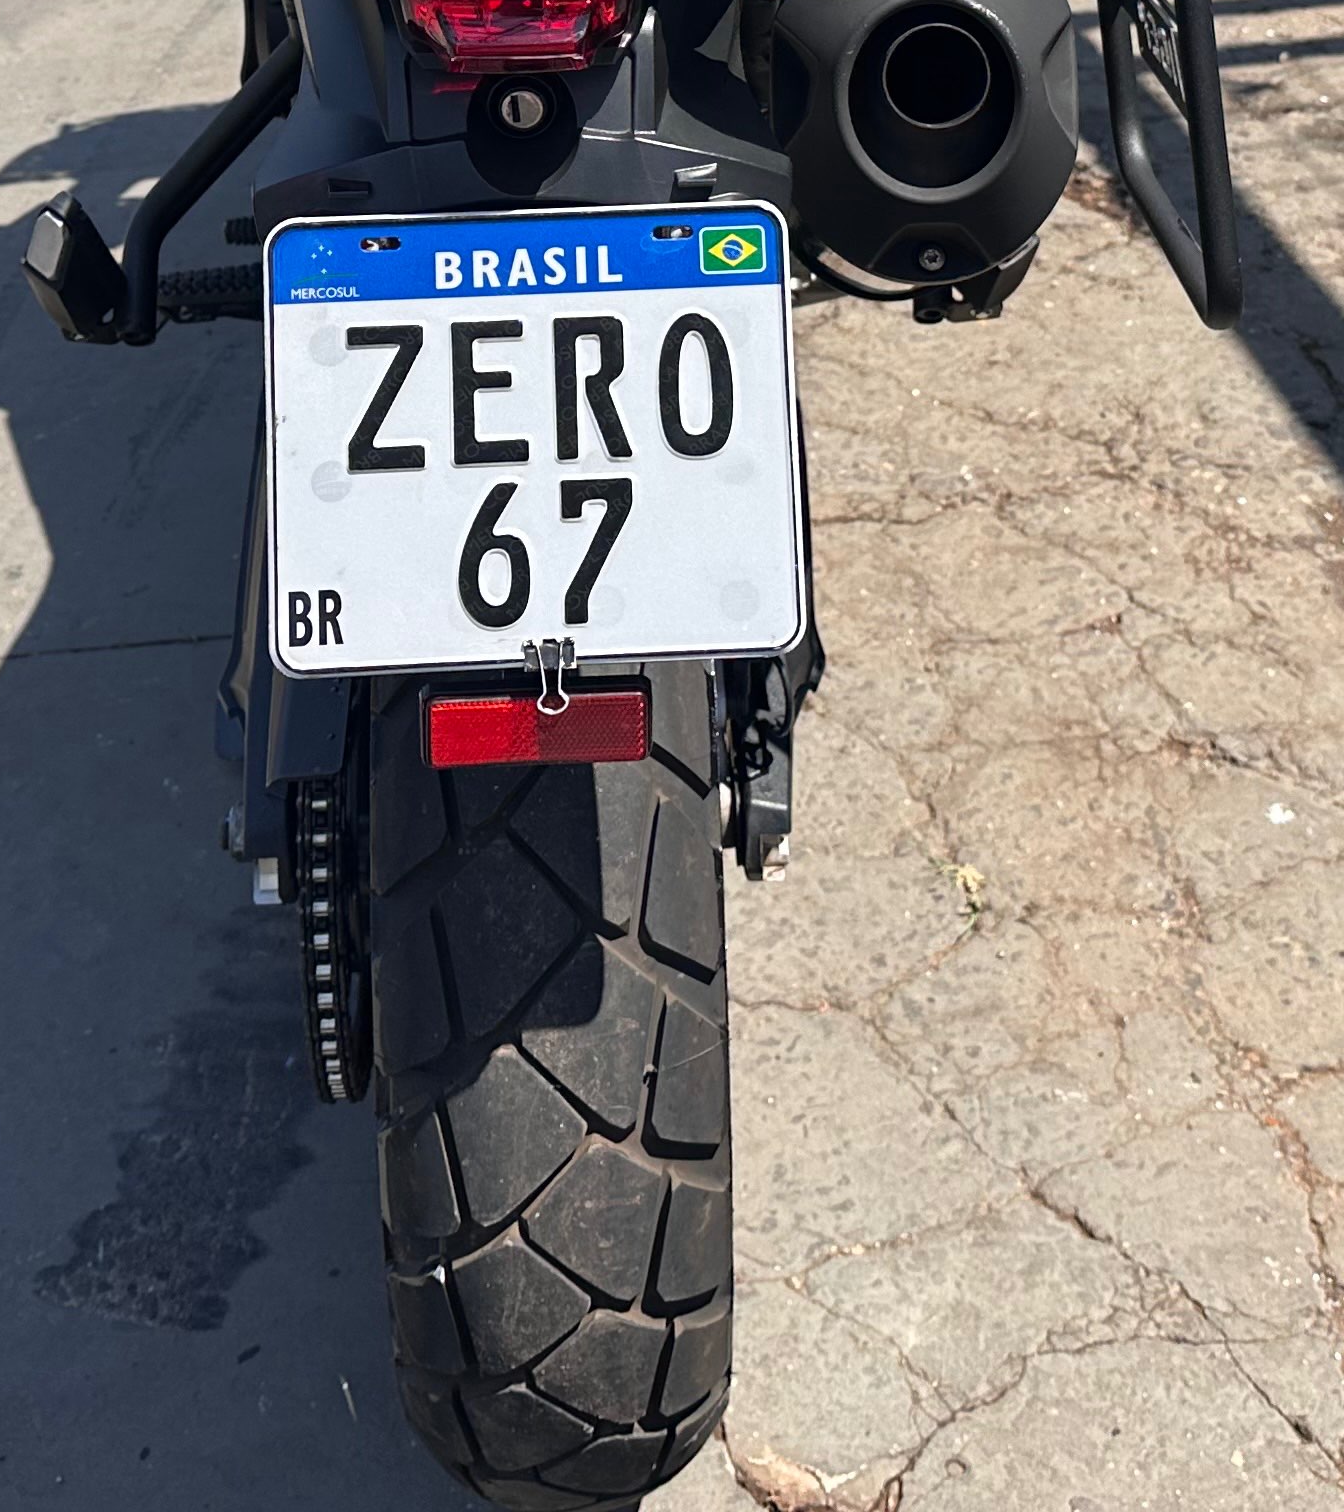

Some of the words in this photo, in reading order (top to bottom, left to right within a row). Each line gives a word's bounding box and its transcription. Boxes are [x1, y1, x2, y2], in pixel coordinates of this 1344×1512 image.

[290, 285, 361, 300] MERCOSUL
[434, 245, 623, 290] BRASIL
[345, 312, 734, 473] ZERO
[458, 477, 634, 629] 67
[287, 589, 344, 648] BR
